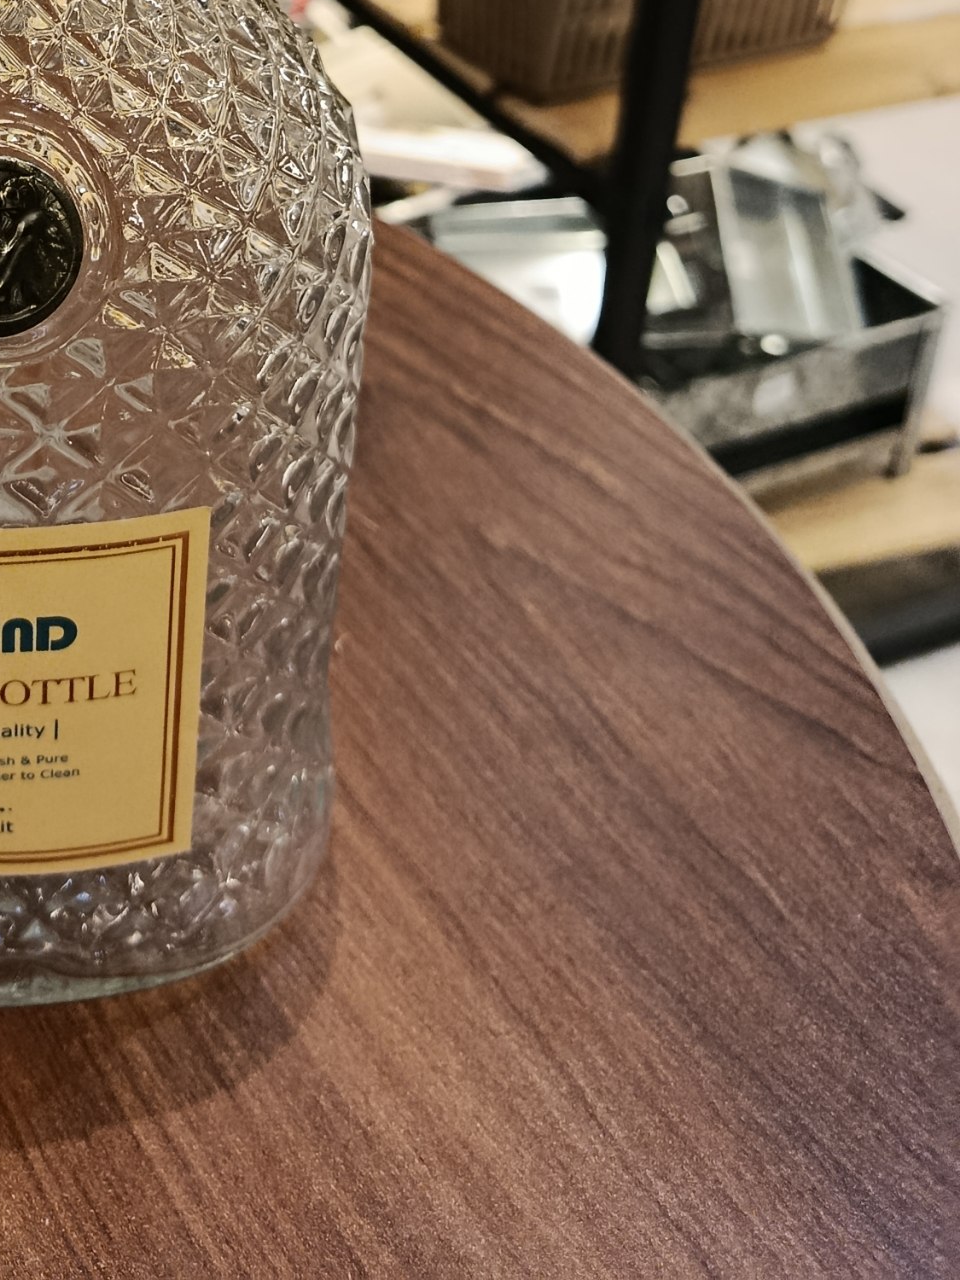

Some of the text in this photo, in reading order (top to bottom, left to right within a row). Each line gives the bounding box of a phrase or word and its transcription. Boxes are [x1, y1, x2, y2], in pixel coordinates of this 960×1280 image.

[20, 755, 32, 766] &
[36, 754, 69, 765] Pure
[20, 771, 36, 781] to
[39, 768, 81, 779] Clean
